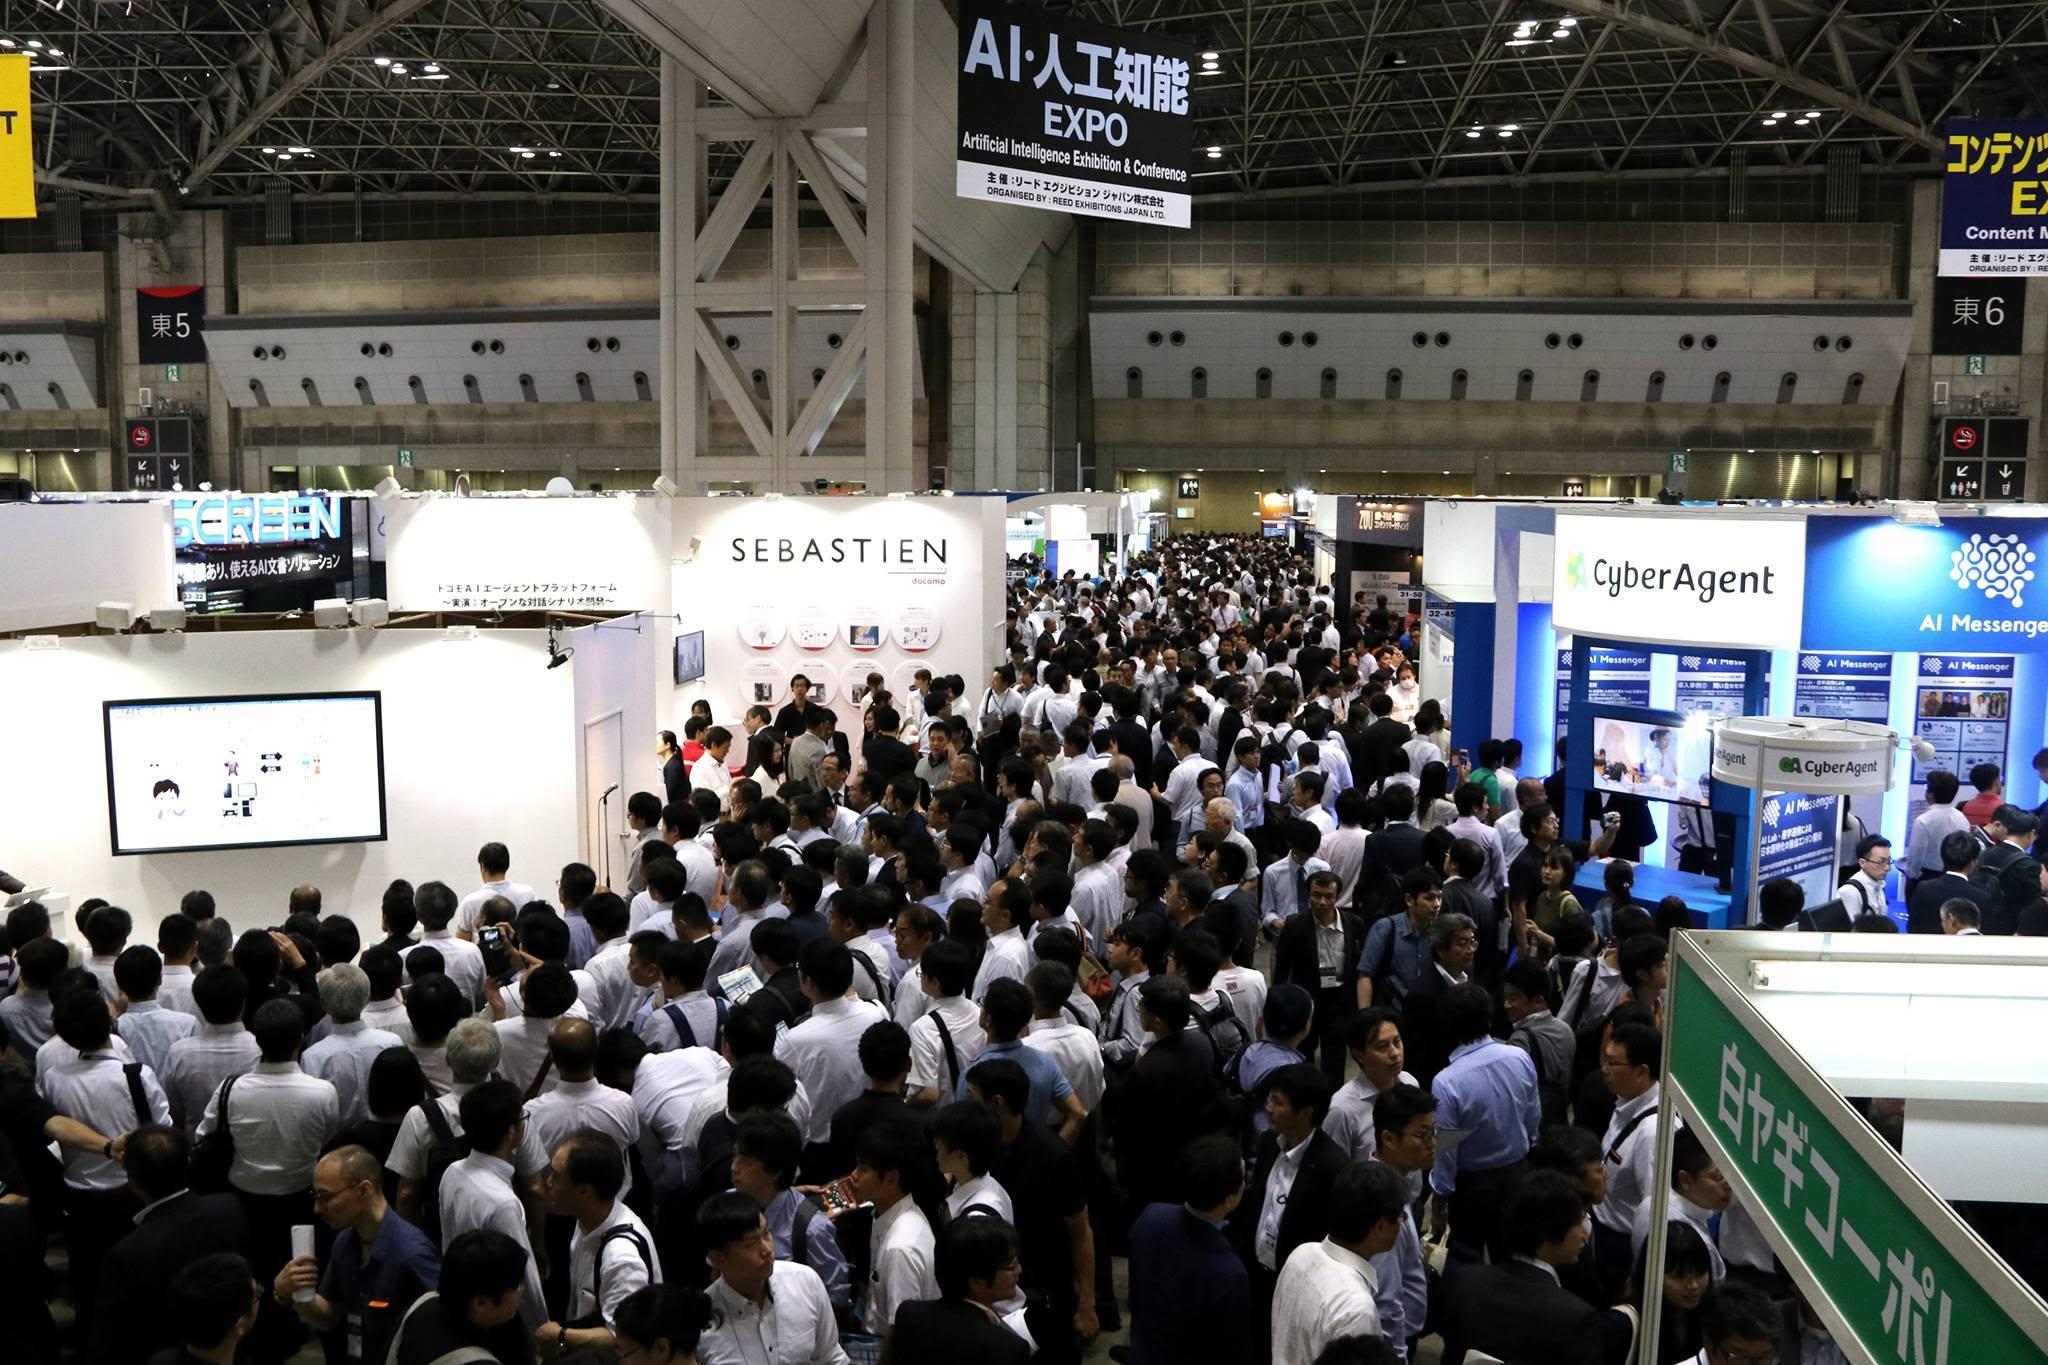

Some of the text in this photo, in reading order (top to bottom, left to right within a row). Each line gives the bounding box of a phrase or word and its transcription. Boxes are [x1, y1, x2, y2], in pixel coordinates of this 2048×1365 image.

[0, 110, 18, 134] T
[1044, 100, 1128, 147] EXPO
[962, 132, 1187, 182] Artificial Intelligence Exhibition & Conference
[987, 187, 1034, 202] ORGANISED
[1036, 194, 1047, 204] BY
[1053, 196, 1074, 208] REED
[1075, 200, 1122, 214] EXHIBITIONS
[1124, 206, 1148, 218] JAPAN
[1150, 210, 1166, 220] LTD.
[1966, 226, 2034, 240] Content
[174, 496, 342, 547] SCREEN
[732, 538, 946, 564] SEBASTIEN
[912, 577, 946, 585] docomo
[1594, 558, 1774, 604] CyberAgent
[1919, 614, 2048, 638] AI Messenge
[1600, 655, 1646, 666] Messenger
[1826, 659, 1887, 671] AI Messenger
[1962, 662, 2010, 672] Messenger
[1804, 760, 1878, 777] CyberAgent
[1784, 795, 1836, 816] AI Messenger
